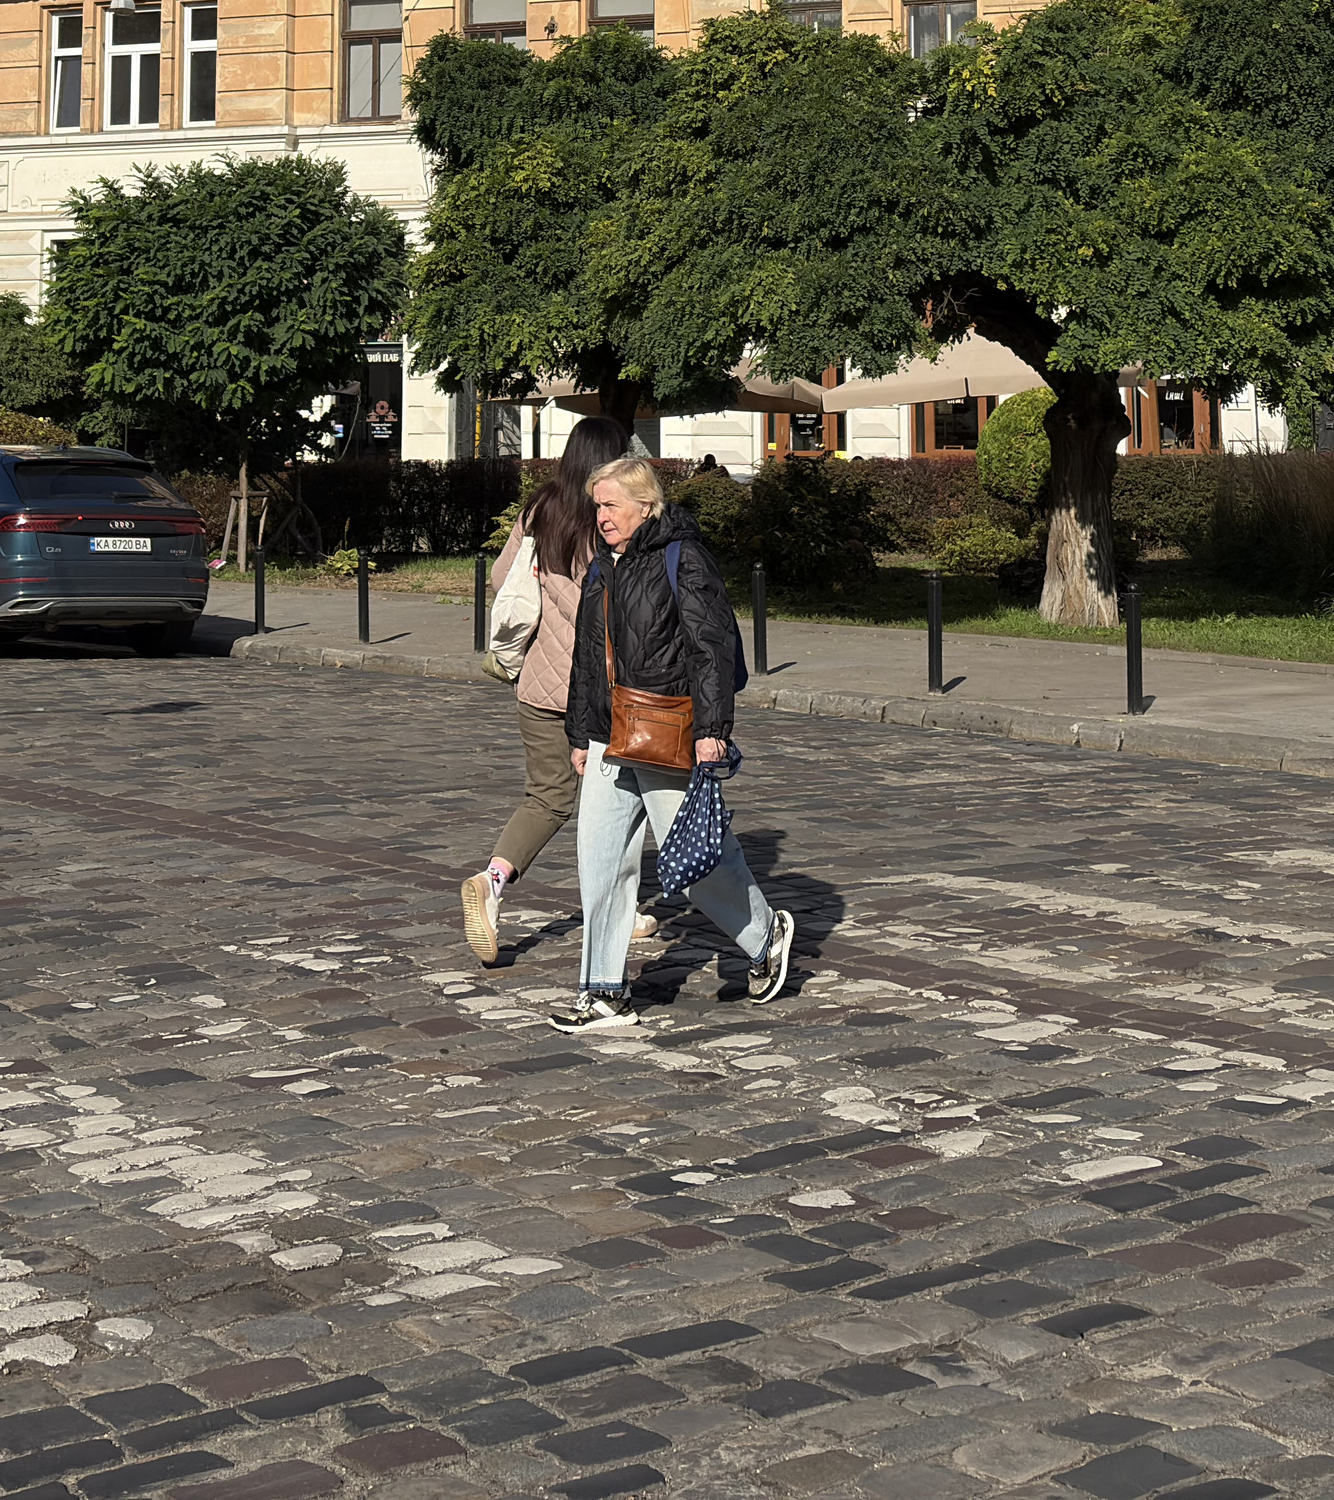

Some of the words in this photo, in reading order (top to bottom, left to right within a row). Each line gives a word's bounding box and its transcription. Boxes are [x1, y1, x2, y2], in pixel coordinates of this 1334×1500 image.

[382, 353, 400, 363] ПАБ
[96, 539, 110, 550] KA
[111, 539, 133, 550] 8720
[135, 539, 148, 550] BA
